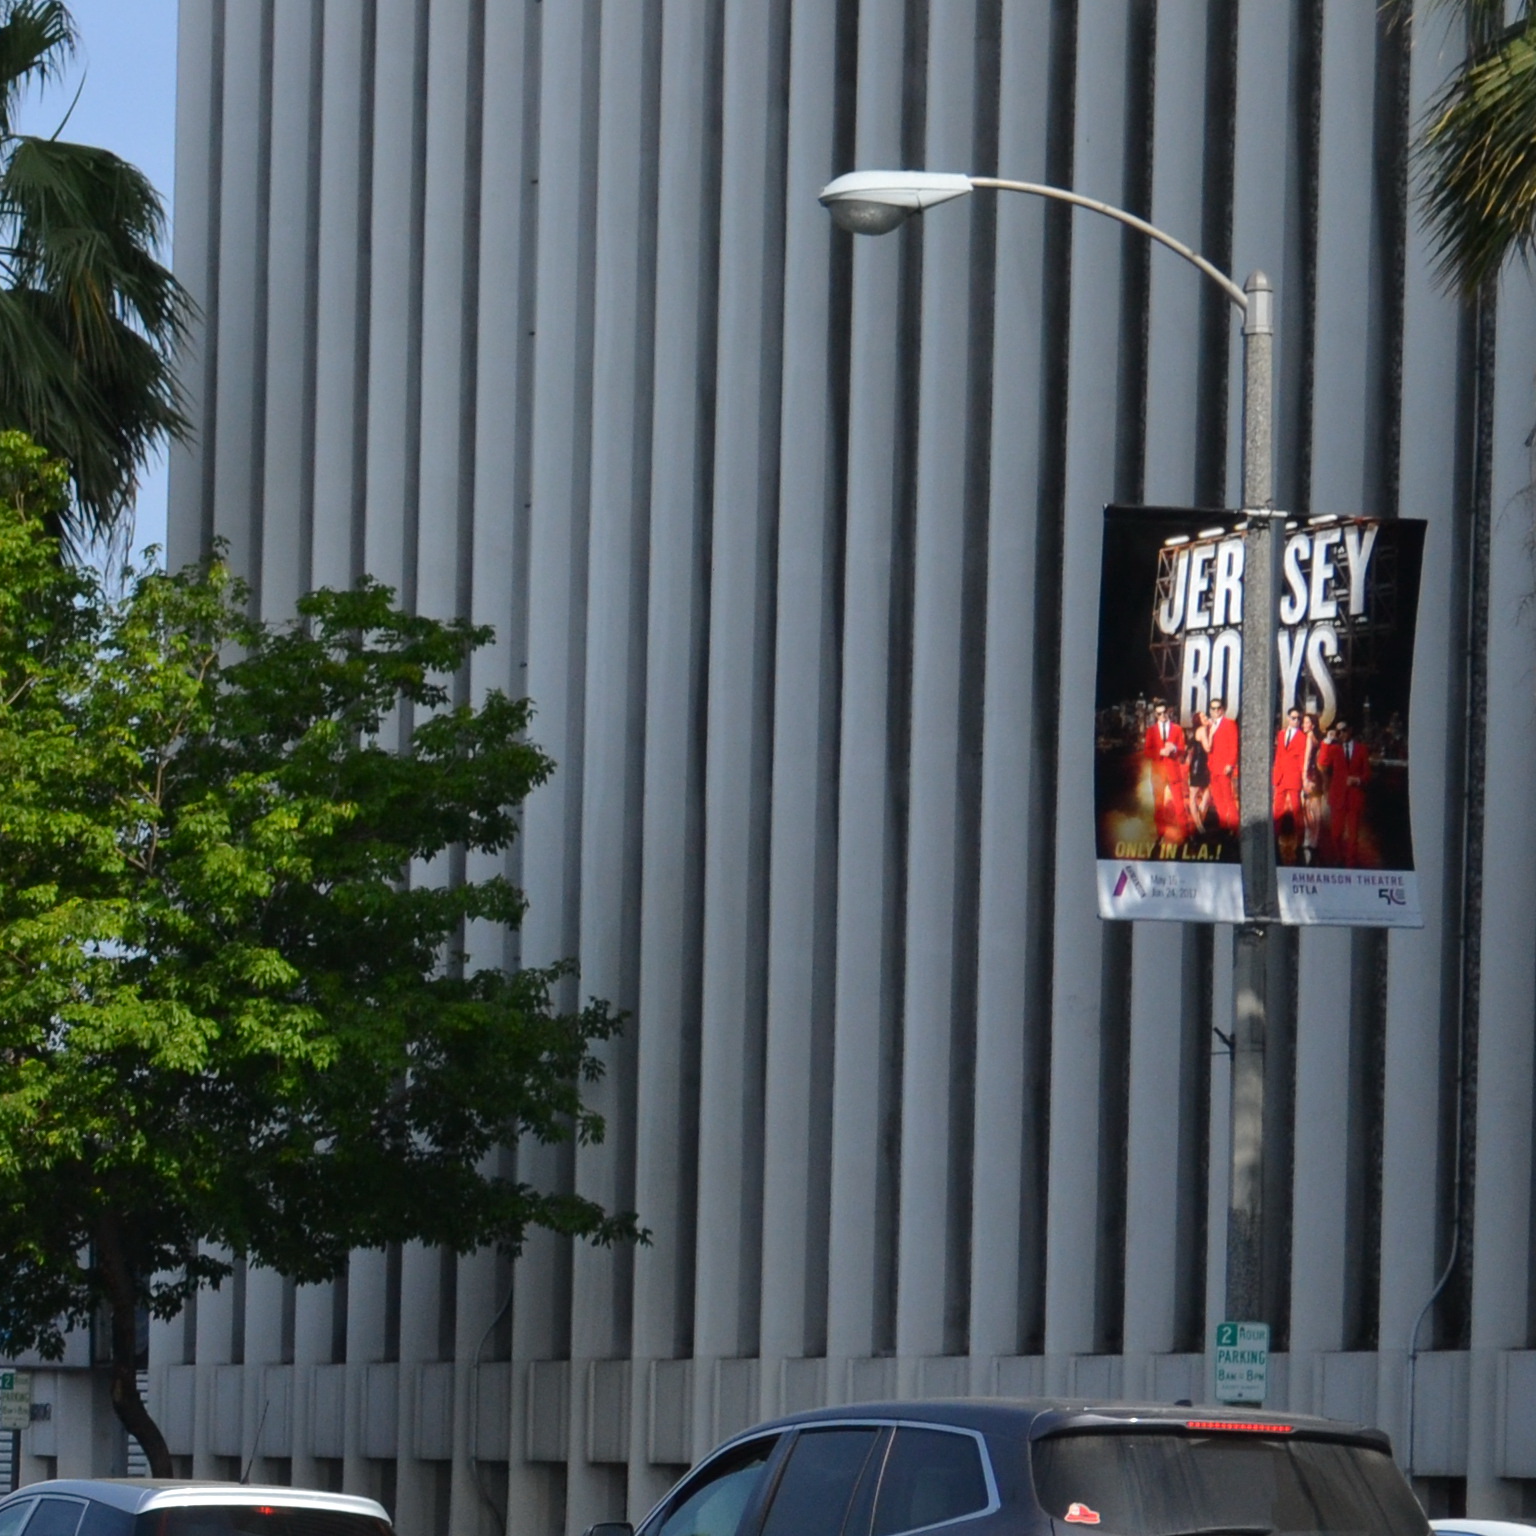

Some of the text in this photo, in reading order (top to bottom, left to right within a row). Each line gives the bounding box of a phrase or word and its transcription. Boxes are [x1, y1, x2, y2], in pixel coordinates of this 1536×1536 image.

[1158, 525, 1378, 634] JERSEY
[1181, 624, 1338, 729] BOYS
[1115, 841, 1222, 860] ONLY IN L.A.!
[1292, 873, 1404, 886] AHMANSON THEATRE
[1292, 885, 1318, 895] DTLA
[1222, 1327, 1232, 1344] 2
[1218, 1350, 1265, 1365] PARKING
